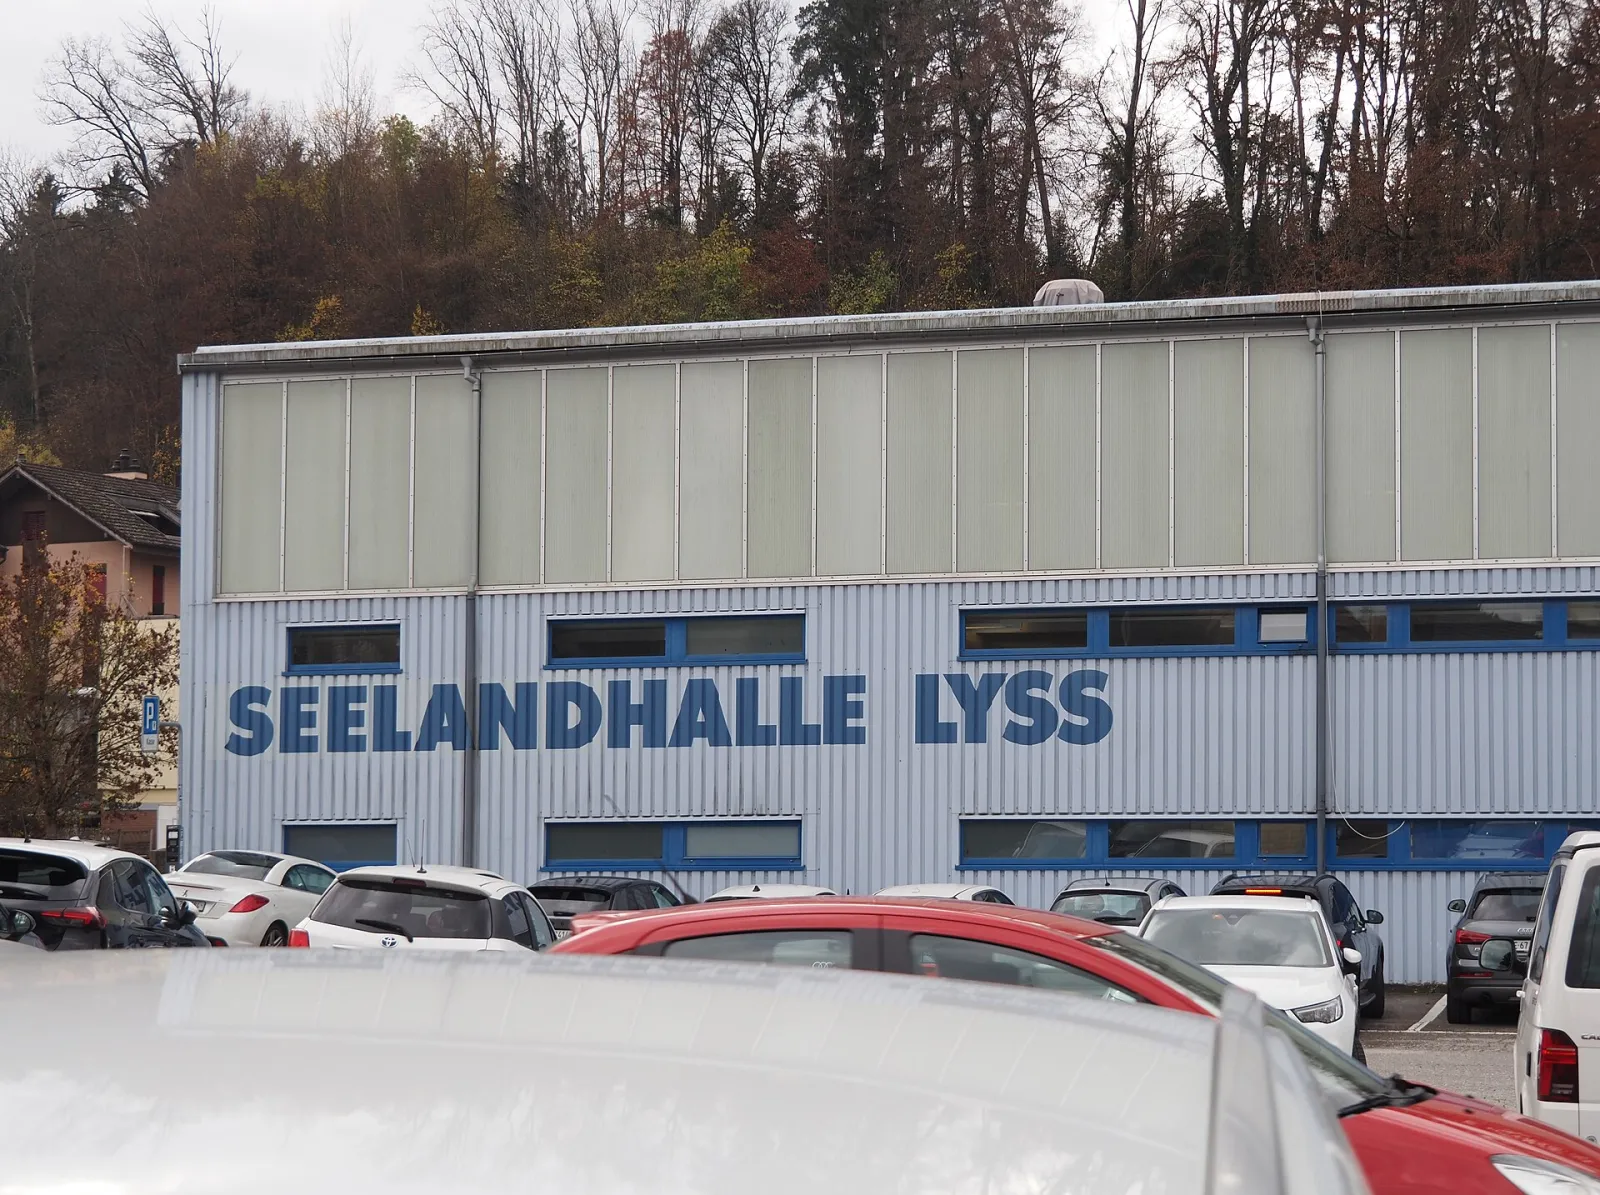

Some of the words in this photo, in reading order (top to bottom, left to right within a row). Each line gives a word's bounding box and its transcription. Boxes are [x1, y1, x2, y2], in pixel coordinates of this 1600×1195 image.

[146, 702, 155, 729] P
[225, 675, 867, 757] SEELANDHALLE
[915, 669, 1114, 746] LYSS
